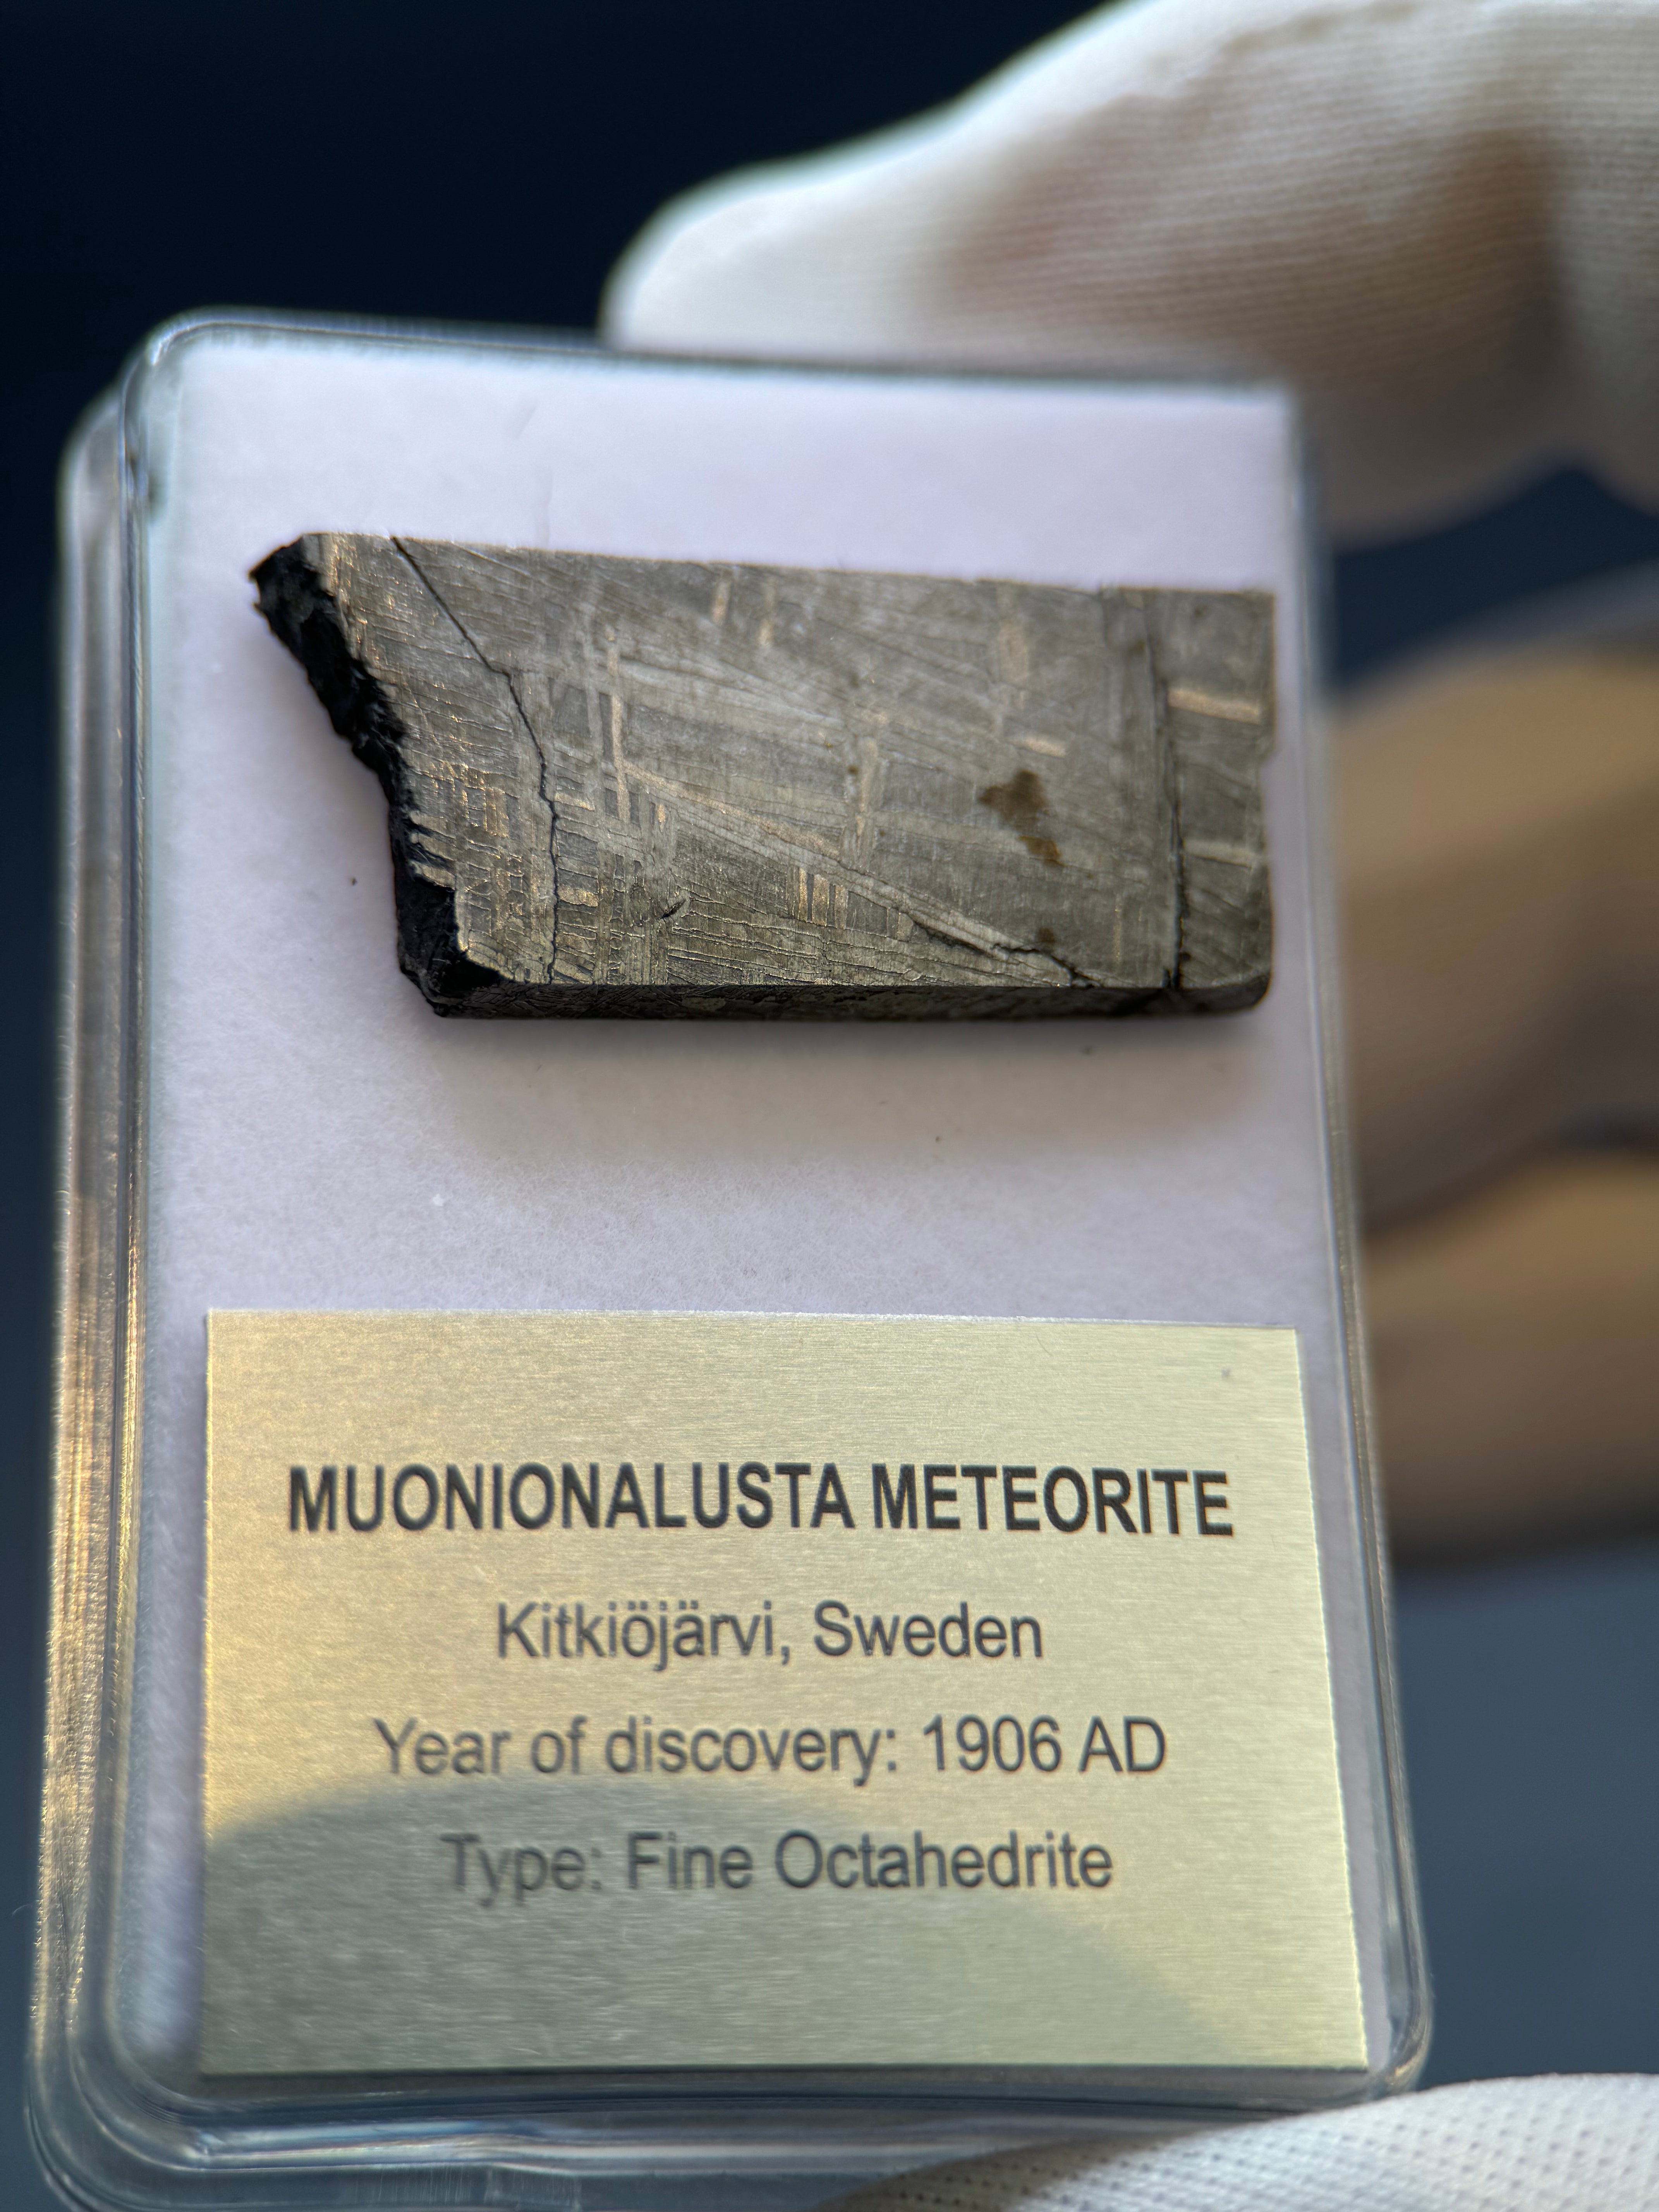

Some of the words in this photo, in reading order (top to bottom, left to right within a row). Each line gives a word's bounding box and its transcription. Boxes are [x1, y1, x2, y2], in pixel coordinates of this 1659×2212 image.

[288, 1462, 856, 1532] MUONIONALUSTA
[873, 1462, 1235, 1536] METEORITE
[496, 1600, 791, 1671] Kitkiöjärvi,
[812, 1599, 1044, 1659] Sweden
[374, 1717, 511, 1776] Year
[529, 1715, 586, 1774] of
[606, 1715, 898, 1788] discovery:
[922, 1714, 1063, 1773] 1906
[1078, 1716, 1167, 1774] AD
[439, 1832, 603, 1906] Type:
[627, 1831, 754, 1890] Fine
[775, 1829, 1114, 1891] Octahedrite
